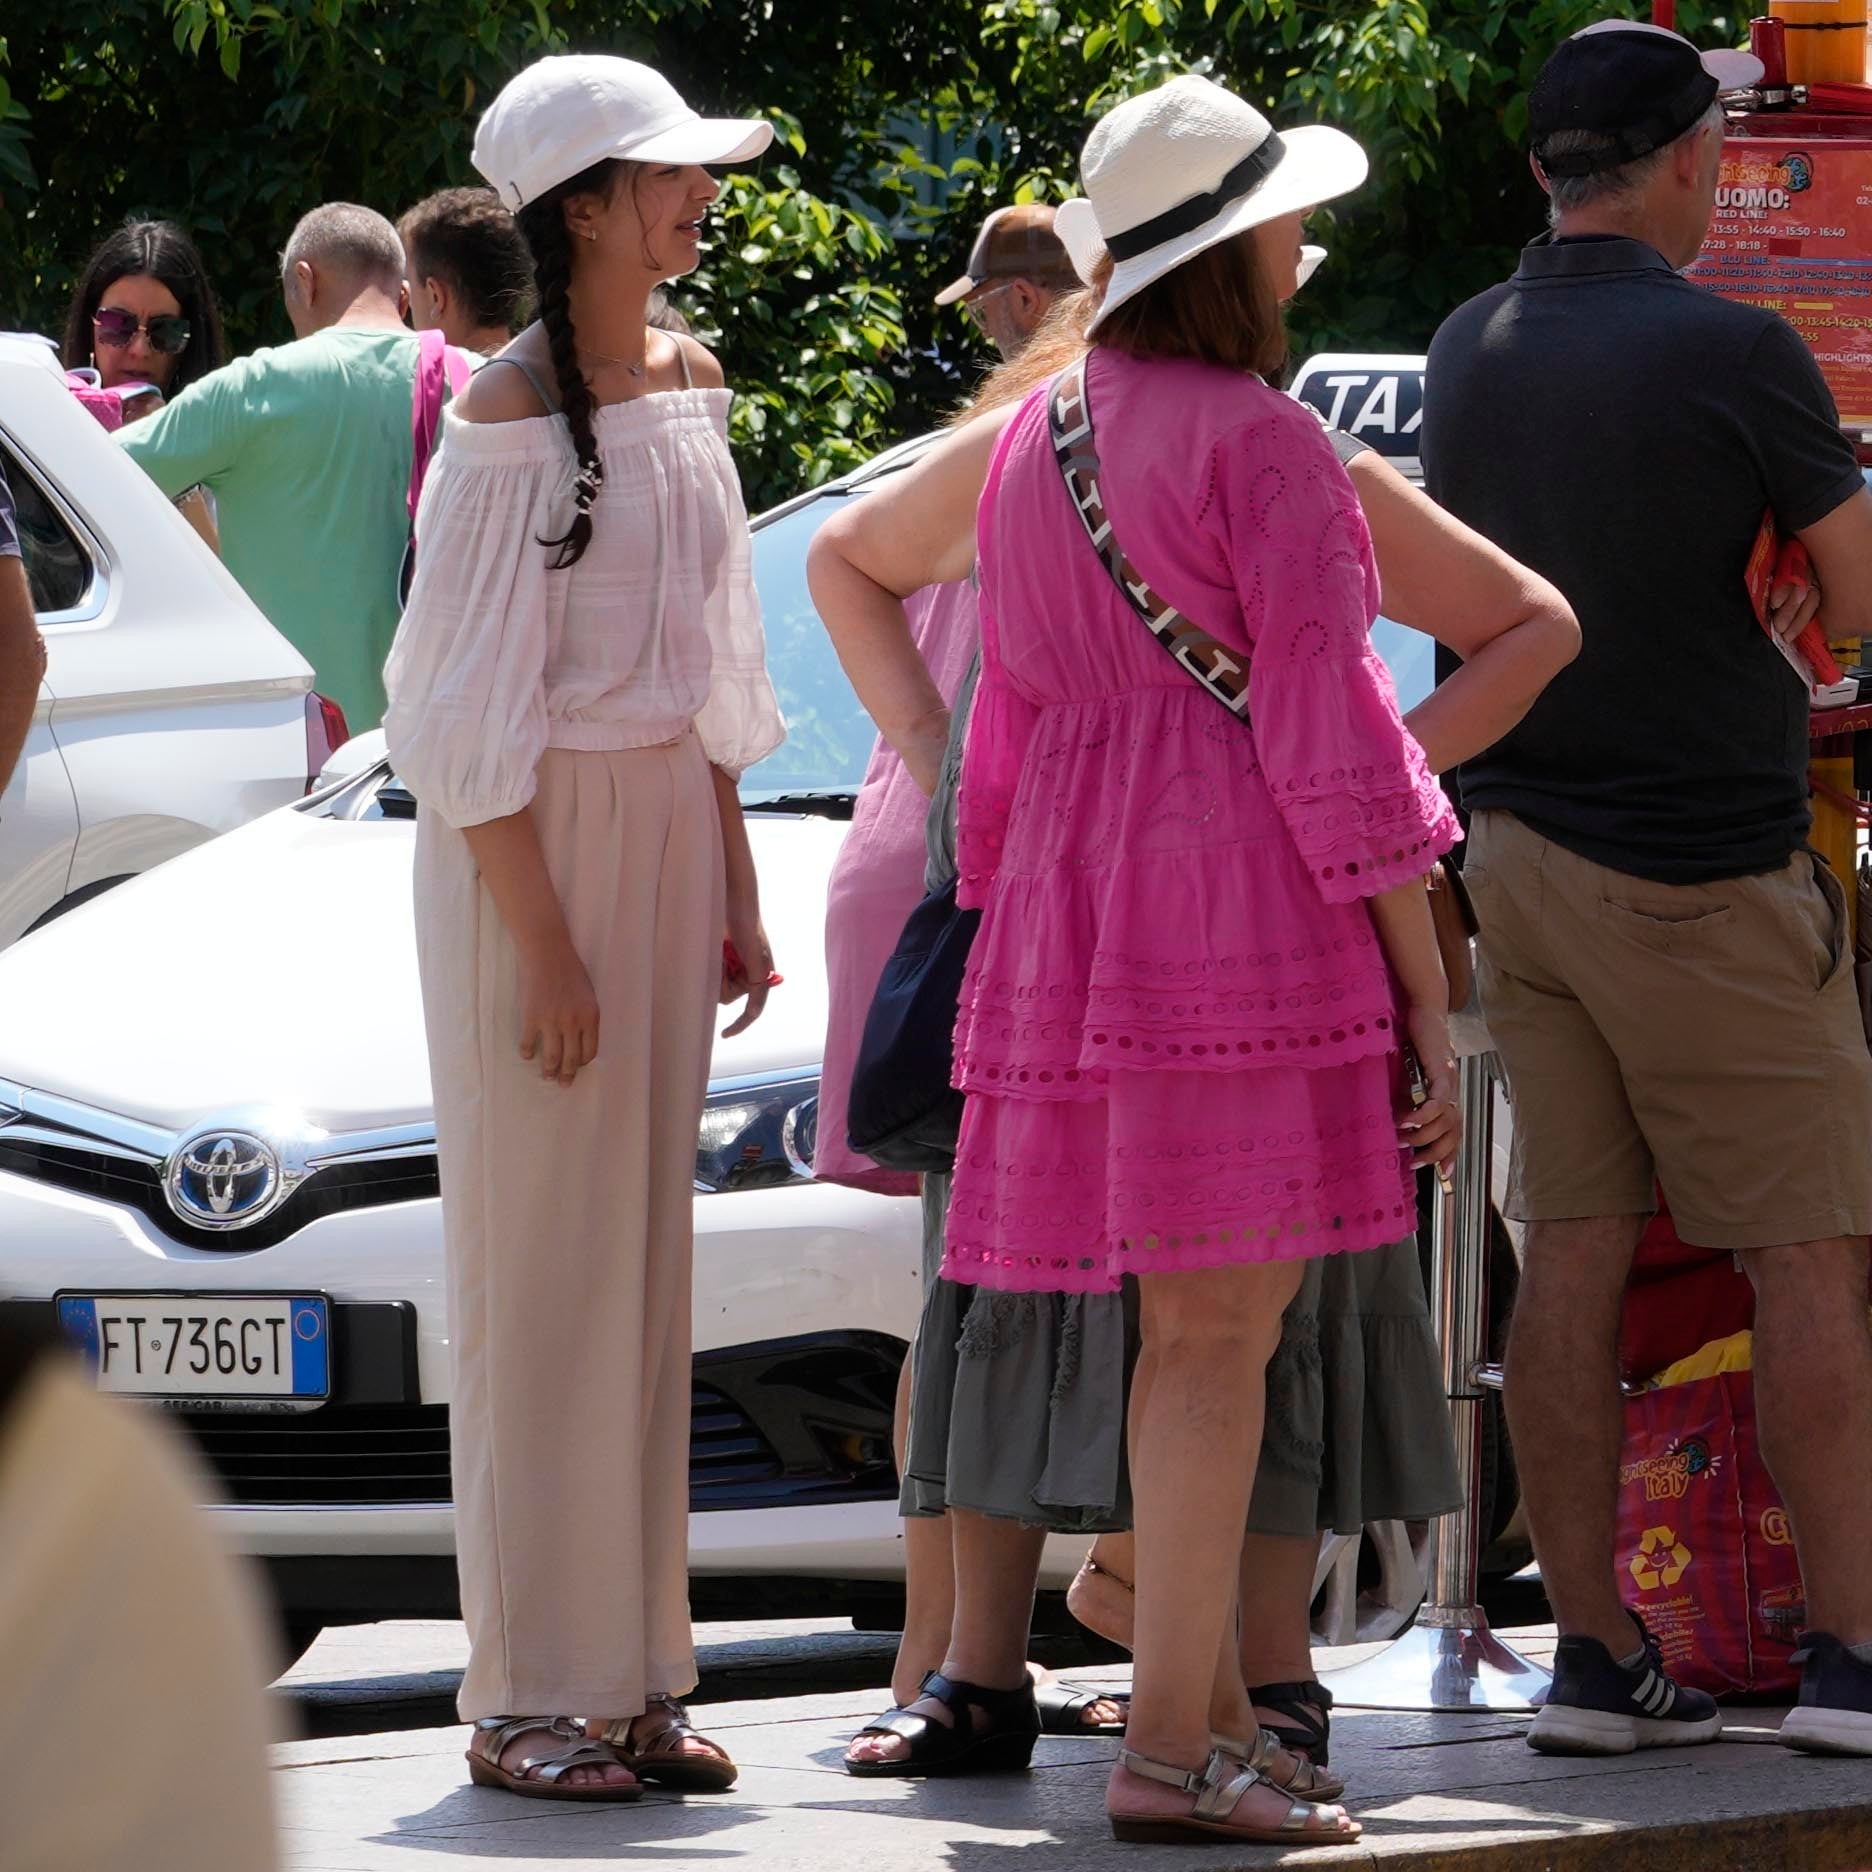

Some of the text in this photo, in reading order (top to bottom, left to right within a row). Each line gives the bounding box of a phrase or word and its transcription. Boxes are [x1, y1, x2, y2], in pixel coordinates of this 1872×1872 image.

[1715, 187, 1790, 209] UOMO:
[1716, 210, 1737, 219] RED
[1325, 375, 1425, 434] TAX
[1646, 1471, 1689, 1501] Italy
